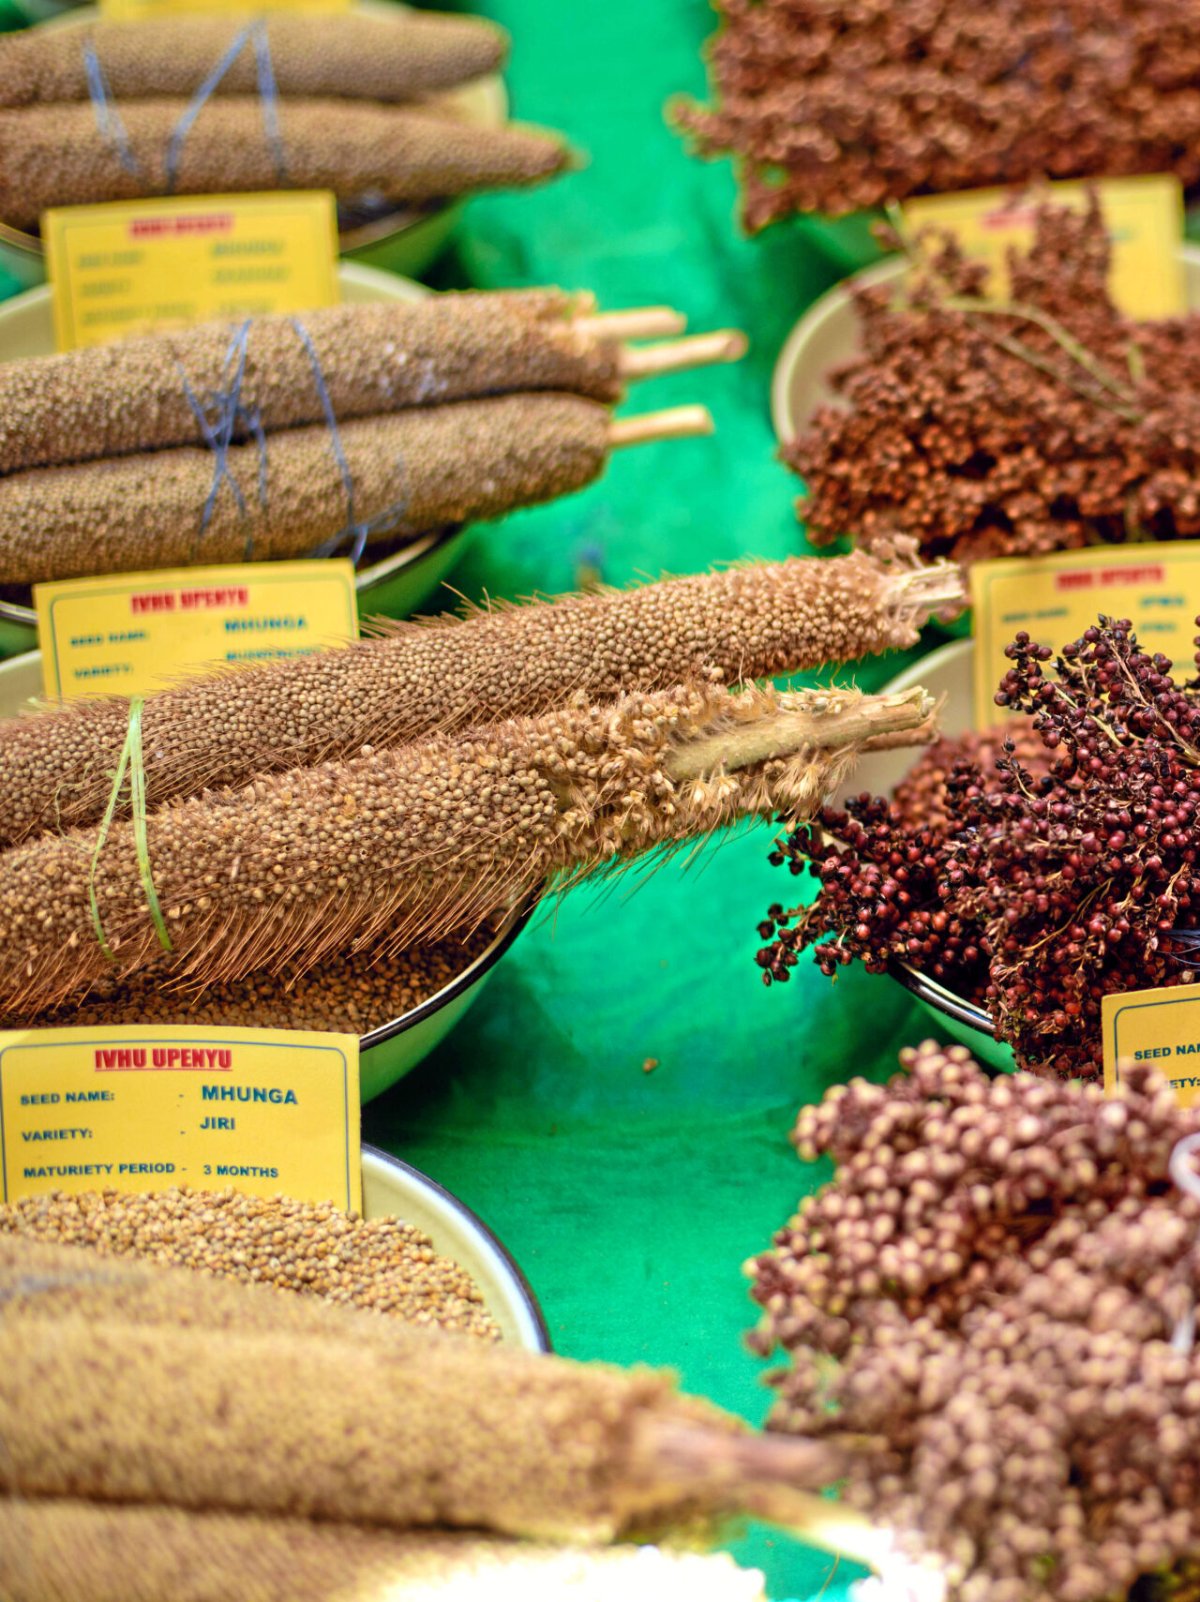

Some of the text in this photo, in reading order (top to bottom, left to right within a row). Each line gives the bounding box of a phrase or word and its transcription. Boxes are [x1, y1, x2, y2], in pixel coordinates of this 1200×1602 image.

[95, 1049, 232, 1070] IVHU UPENYU
[1134, 1046, 1171, 1061] SEED
[20, 1092, 60, 1106] SEED
[65, 1090, 115, 1104] NAME:
[202, 1085, 299, 1105] MHUNGA
[22, 1128, 93, 1142] VARIETY:
[200, 1116, 235, 1131] JIRI
[24, 1163, 113, 1178] MATURIETY
[119, 1162, 175, 1175] PERIOD
[203, 1164, 212, 1176] 3
[216, 1165, 279, 1179] MONTHS
